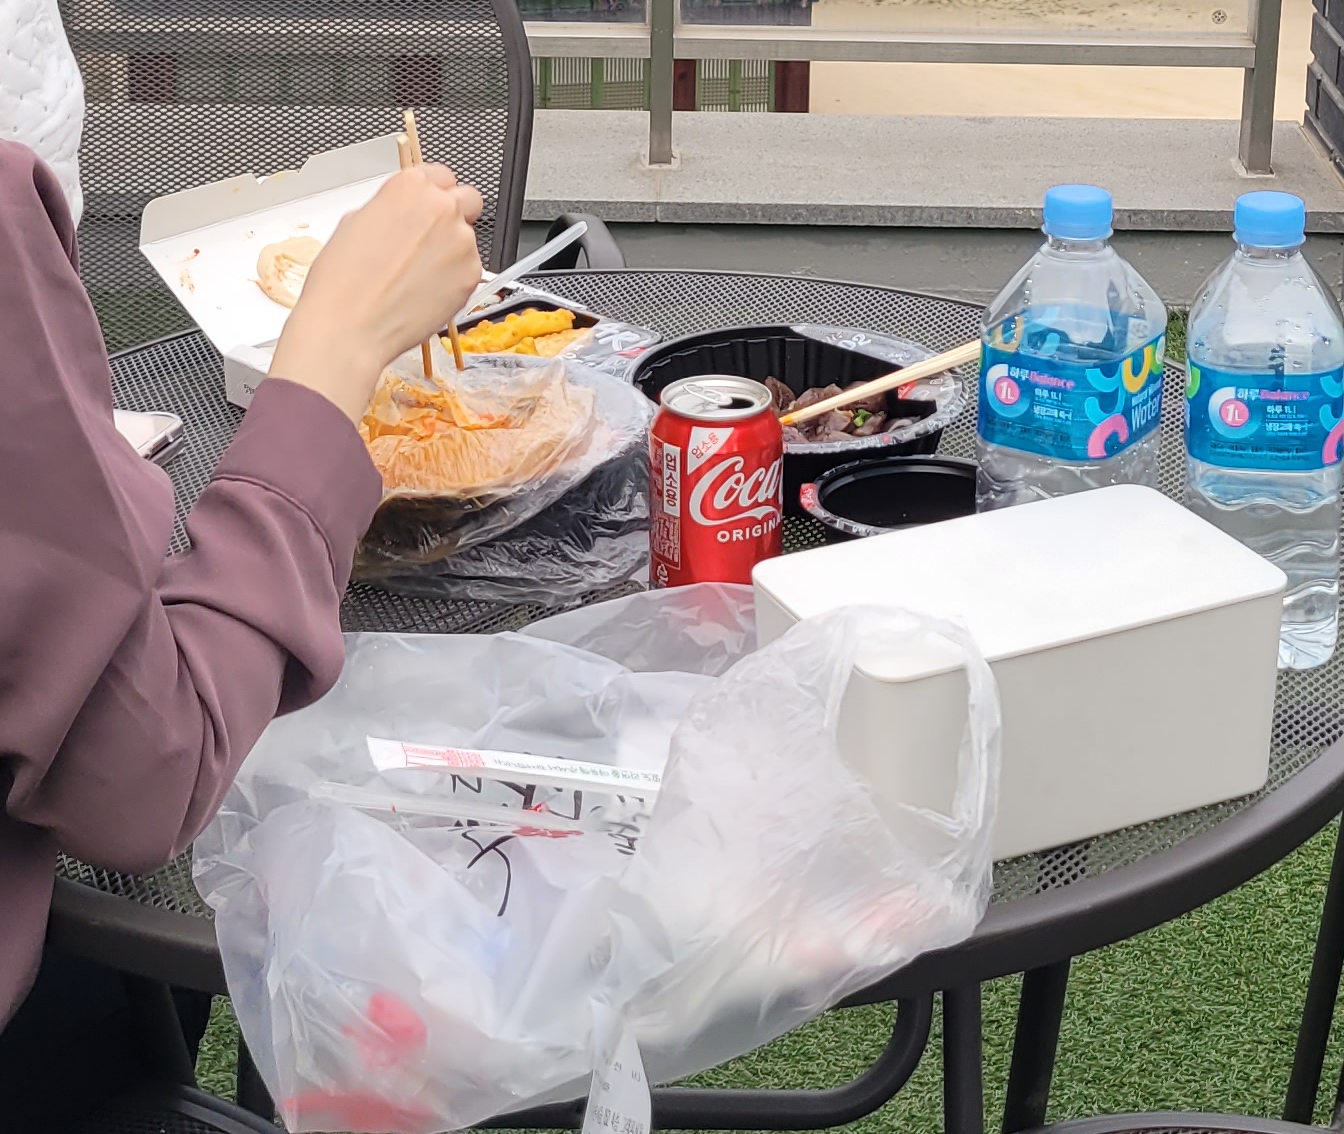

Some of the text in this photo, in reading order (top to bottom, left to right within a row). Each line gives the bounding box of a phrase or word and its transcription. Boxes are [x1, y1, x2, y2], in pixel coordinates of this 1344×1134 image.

[999, 381, 1015, 400] 1L
[1132, 393, 1161, 432] Water
[1226, 403, 1244, 422] 1L
[691, 432, 719, 460] 업소용
[665, 452, 678, 507] 업소용
